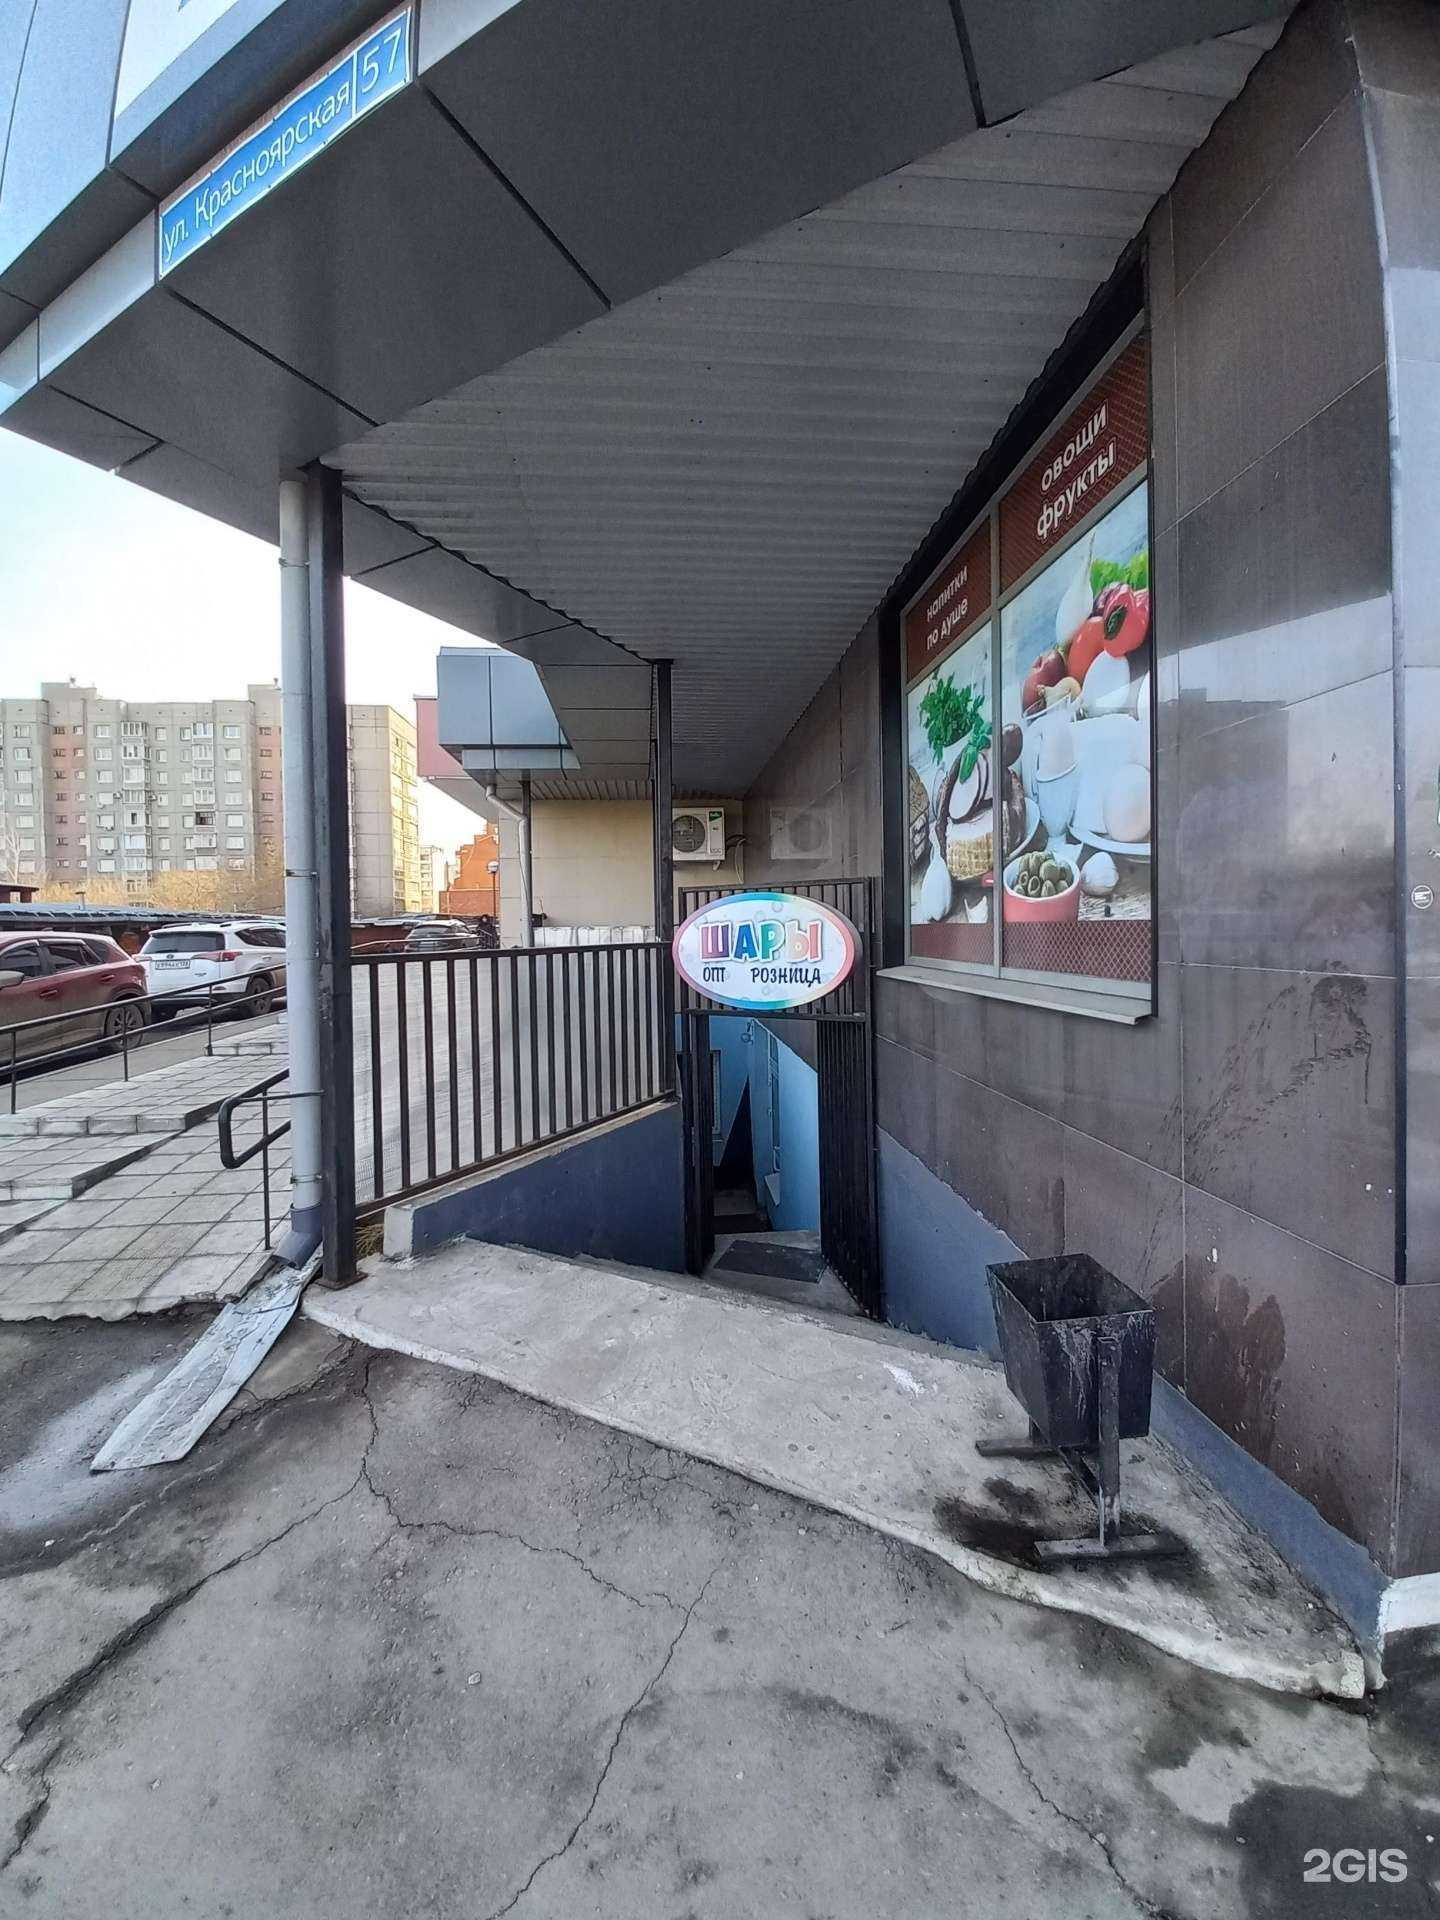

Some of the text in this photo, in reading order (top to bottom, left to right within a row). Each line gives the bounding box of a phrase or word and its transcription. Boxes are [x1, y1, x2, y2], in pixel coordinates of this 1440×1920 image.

[164, 27, 401, 262] ул. Красноярская 57
[1037, 442, 1114, 540] фрукты
[926, 565, 968, 622] напитки
[927, 629, 939, 650] по
[700, 919, 823, 964] ШАРЫ
[702, 966, 822, 988] ОПТ РОЗНИЦА
